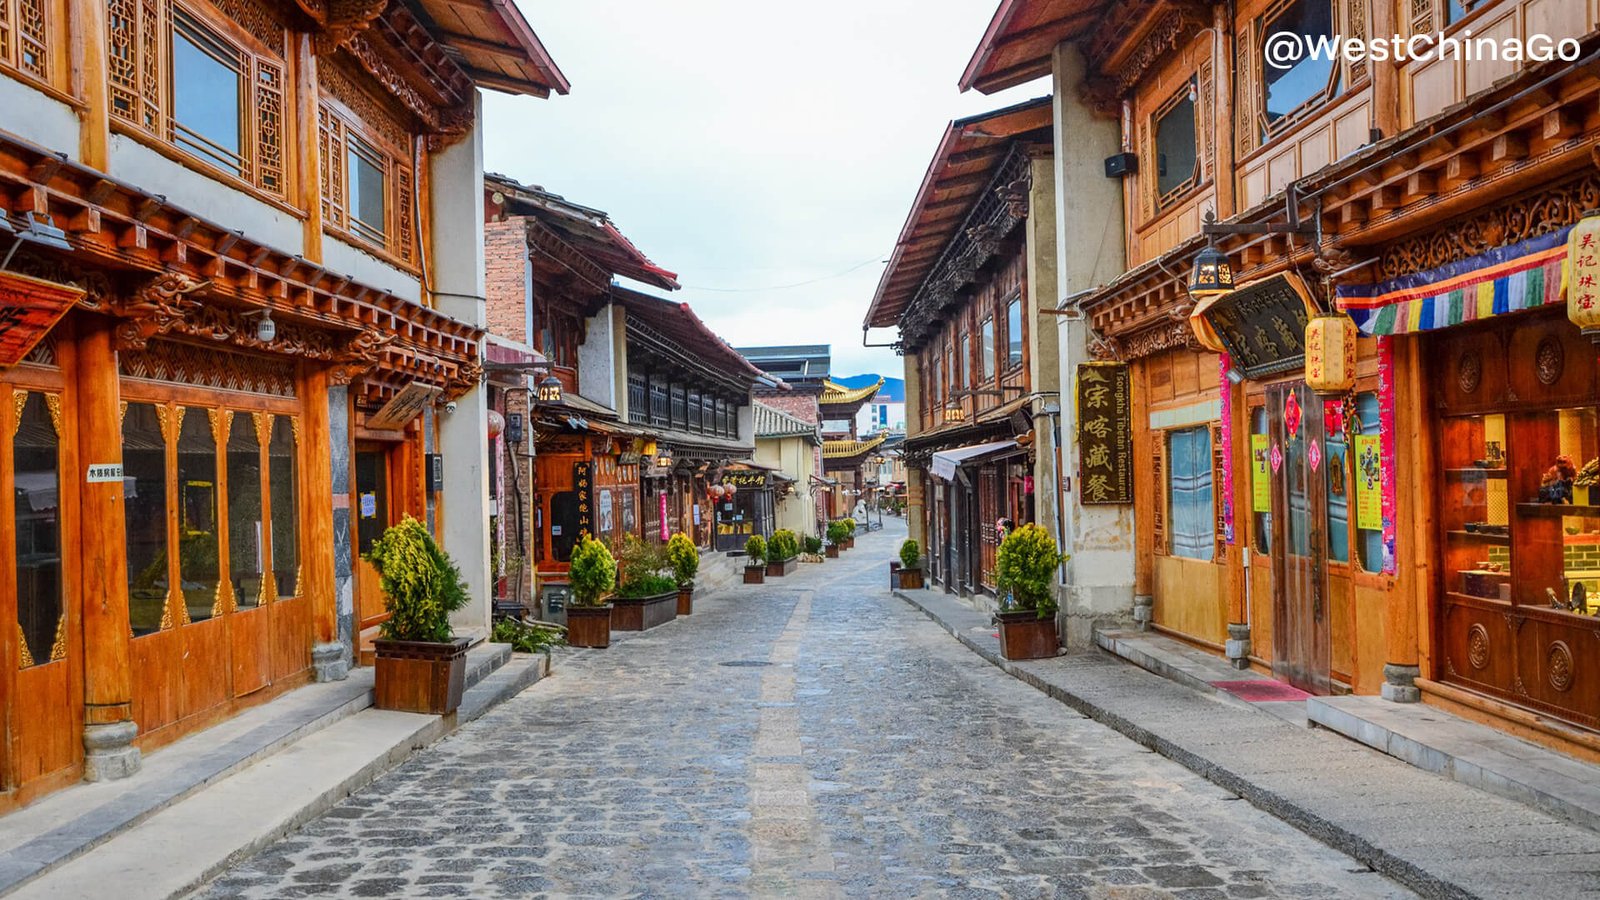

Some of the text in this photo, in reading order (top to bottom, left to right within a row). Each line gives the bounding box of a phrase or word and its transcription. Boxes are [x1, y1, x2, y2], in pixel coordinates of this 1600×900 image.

[1577, 233, 1597, 309] 吴记珠宝
[1084, 384, 1115, 502] 宗喀藏餐
[1115, 370, 1127, 500] Tsongkha Tibetan Restaurant
